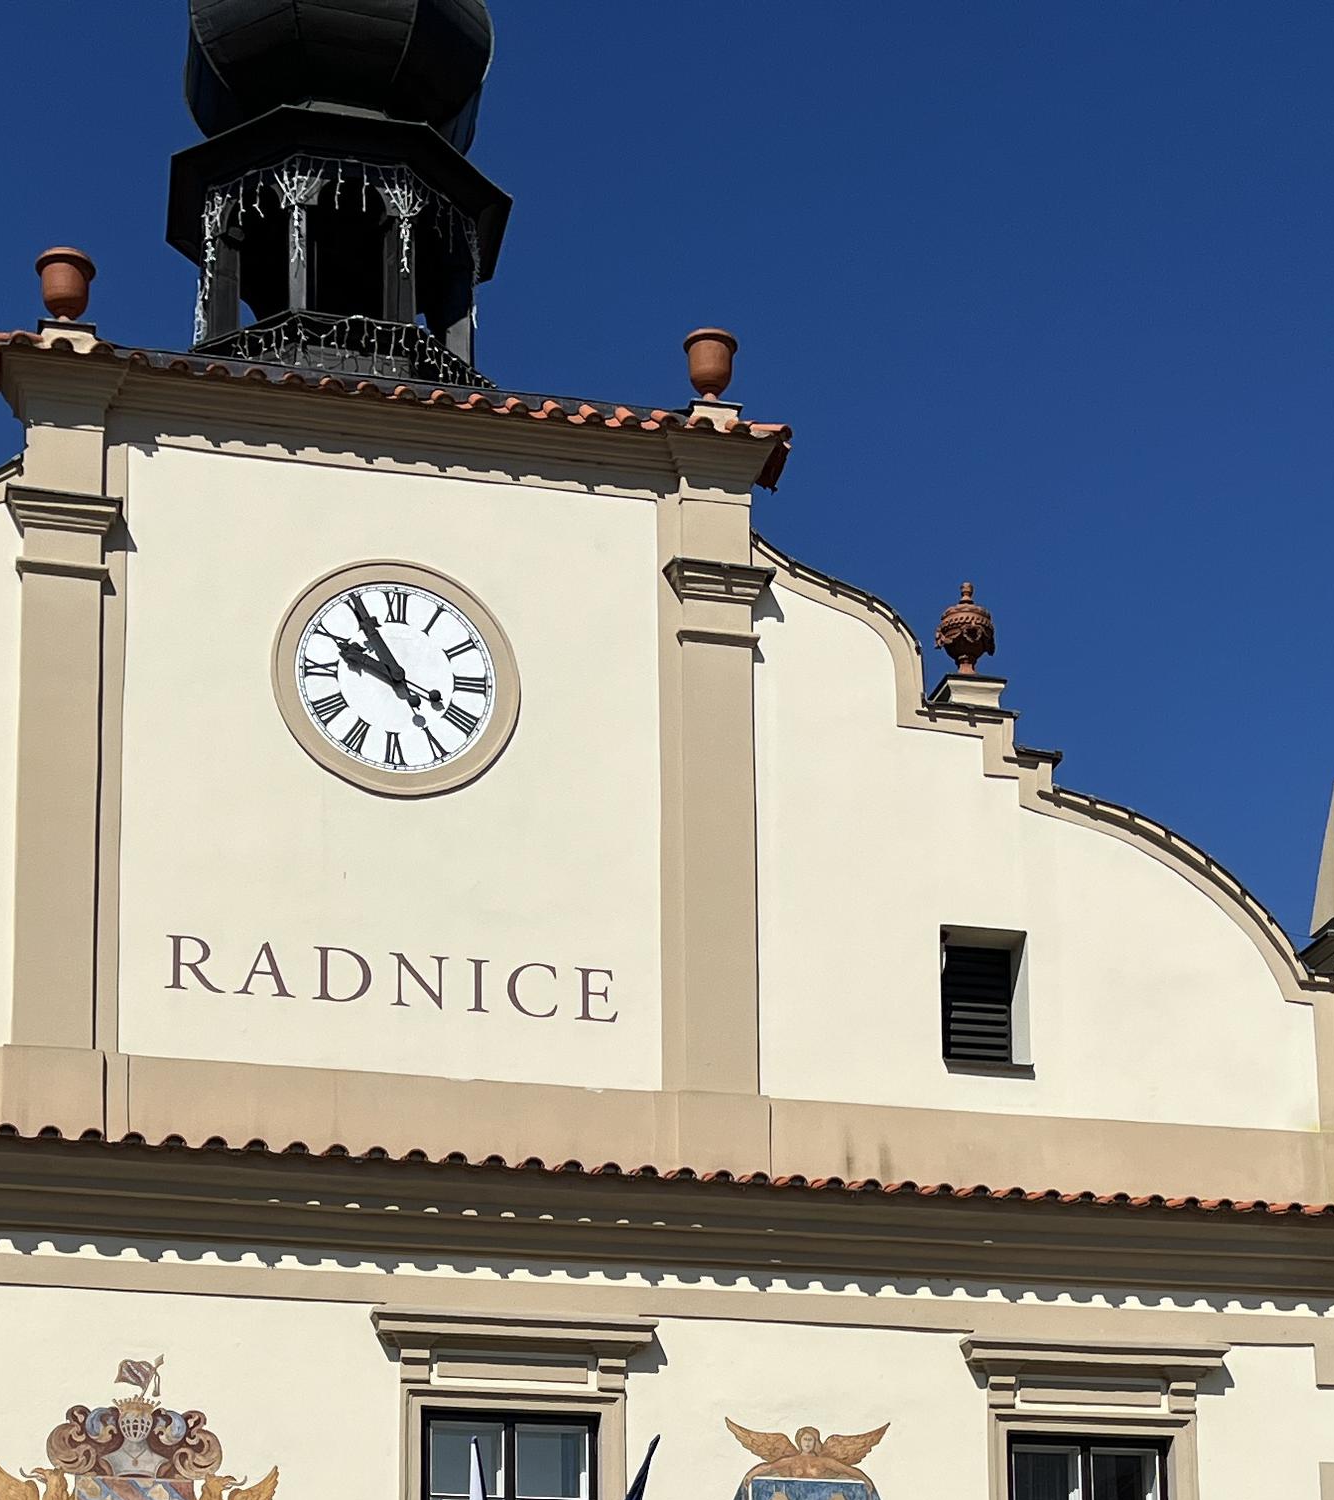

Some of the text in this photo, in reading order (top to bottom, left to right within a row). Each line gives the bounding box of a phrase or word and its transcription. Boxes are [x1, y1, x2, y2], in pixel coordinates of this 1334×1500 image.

[384, 591, 409, 625] XII
[442, 638, 478, 661] II
[452, 674, 487, 698] III
[163, 933, 619, 1024] RADNICE
